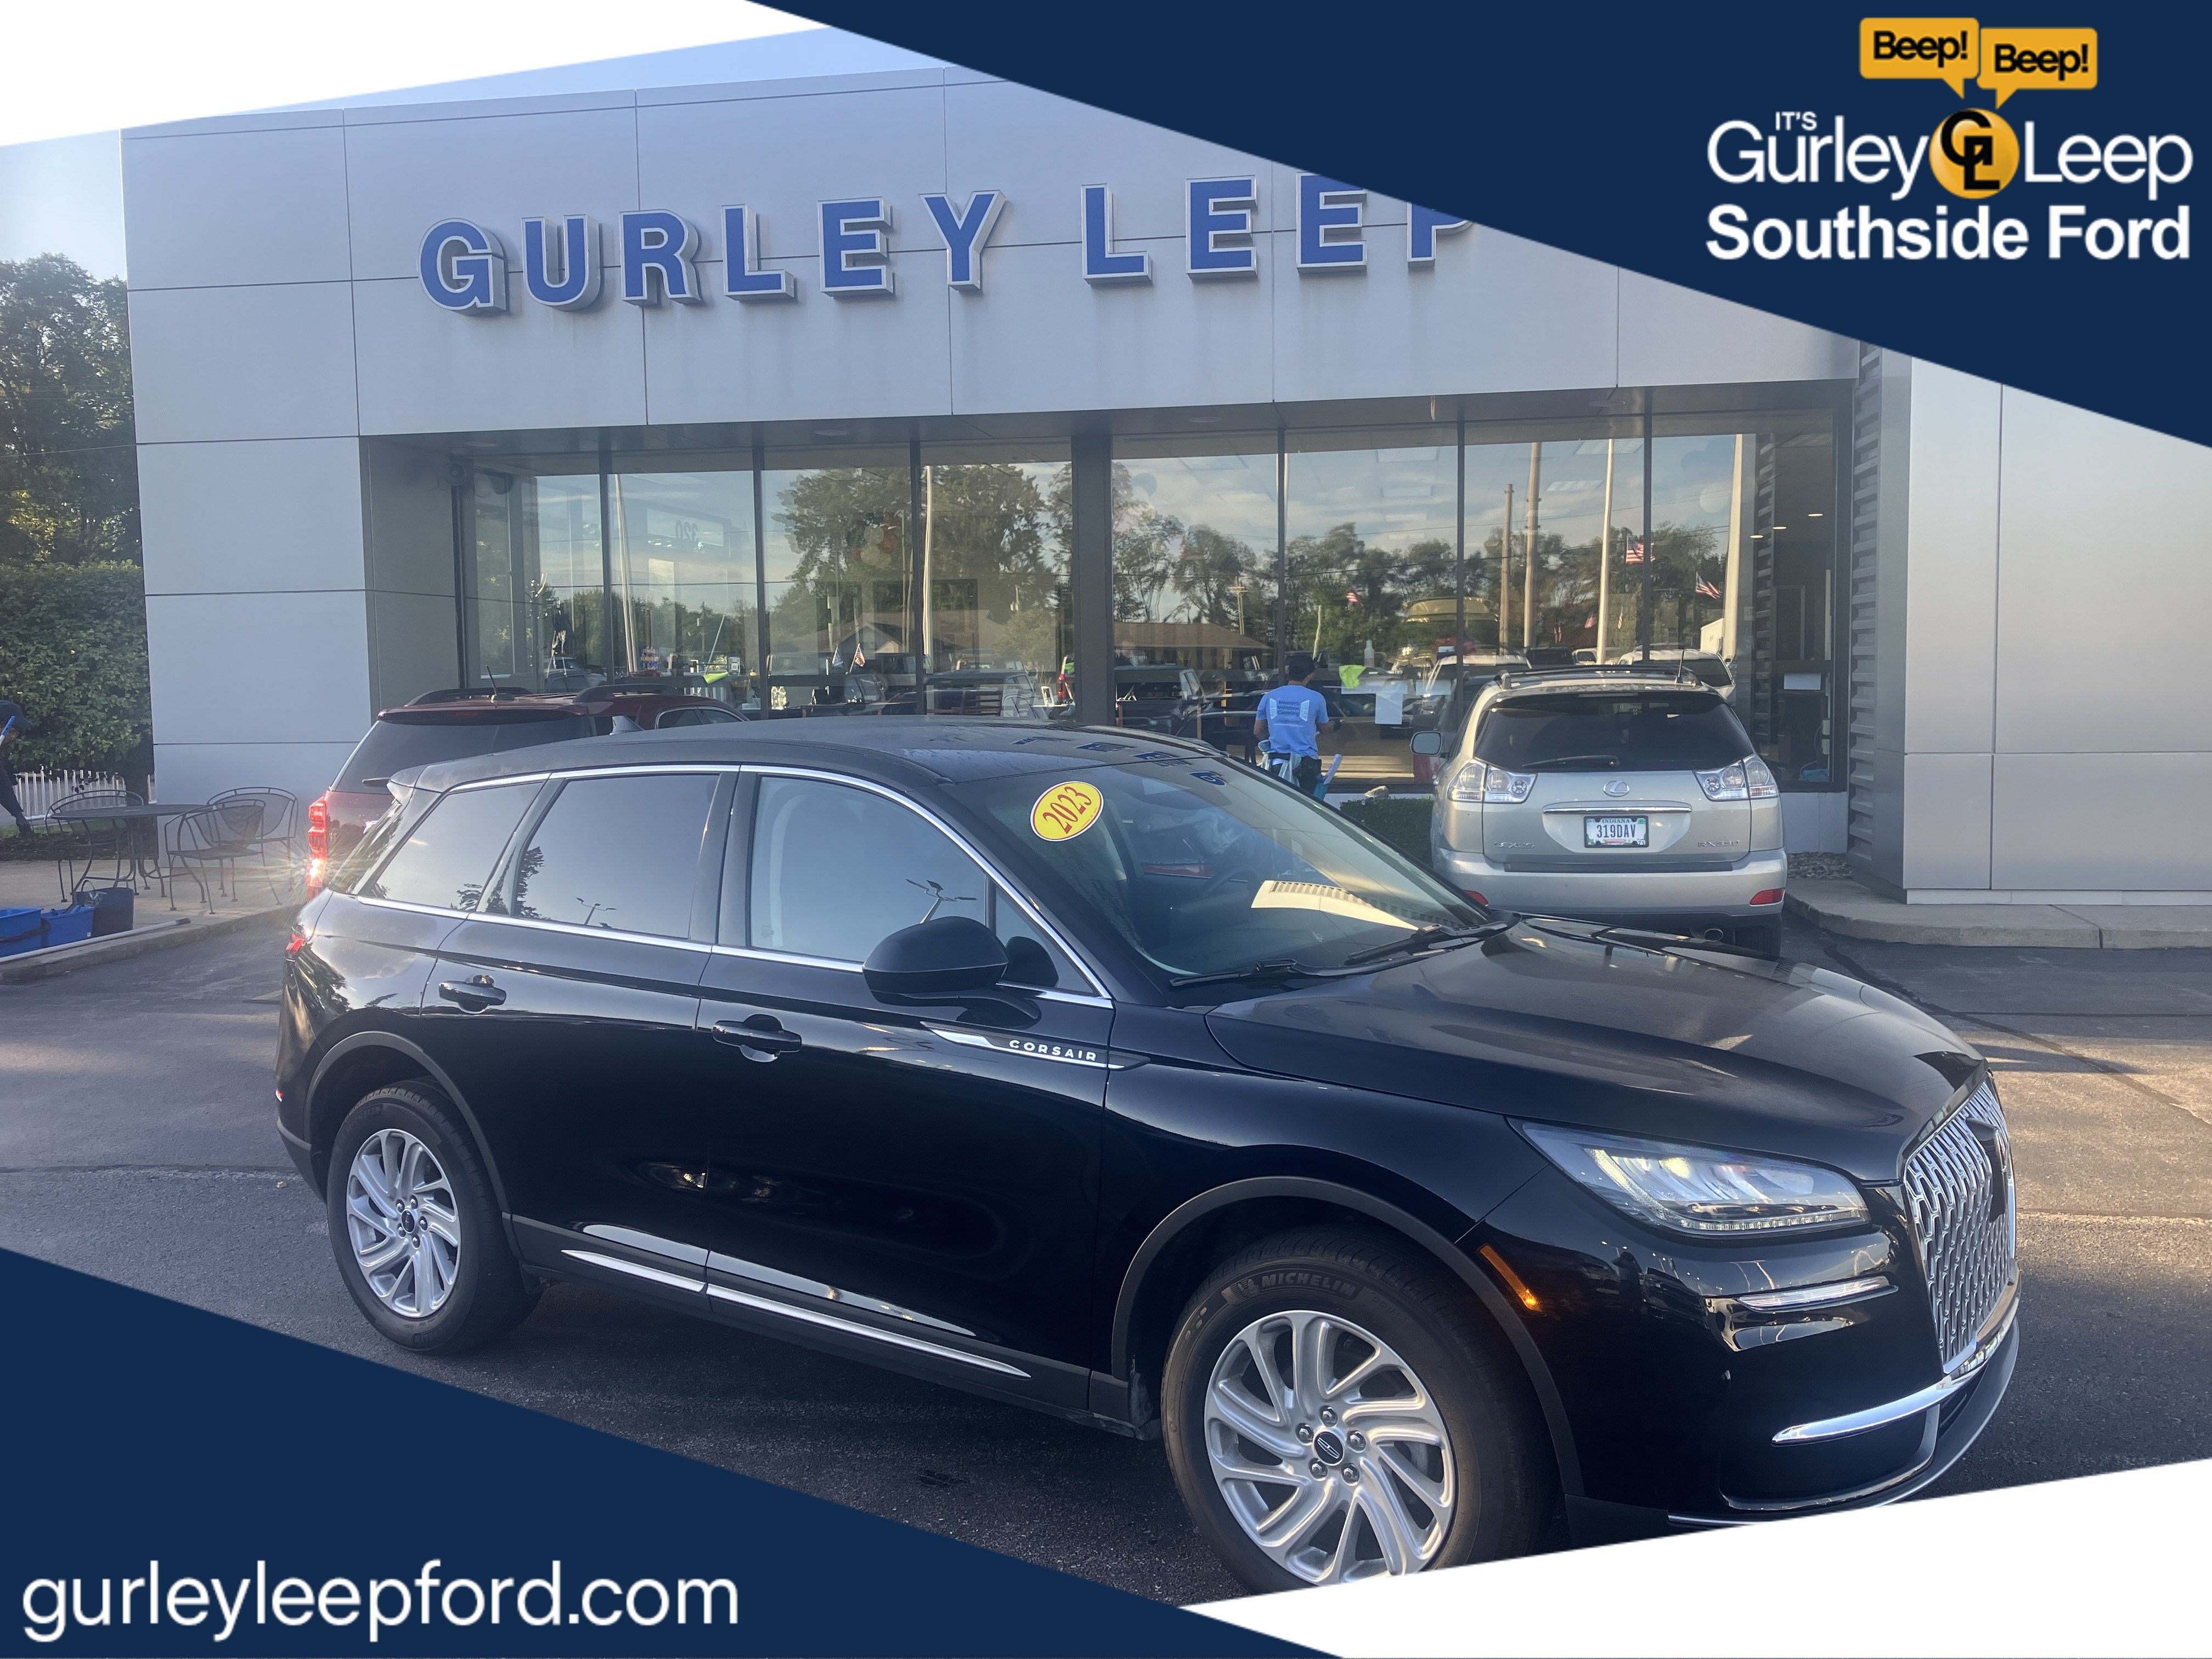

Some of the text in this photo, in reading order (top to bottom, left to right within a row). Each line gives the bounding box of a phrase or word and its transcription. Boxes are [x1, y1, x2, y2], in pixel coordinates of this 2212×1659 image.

[417, 190, 1006, 314] GURLEY
[1042, 786, 1092, 834] 2023
[1596, 824, 1636, 838] 319DAV
[1009, 1040, 1097, 1062] CORSAIR
[1262, 1272, 1356, 1296] MICHELIN
